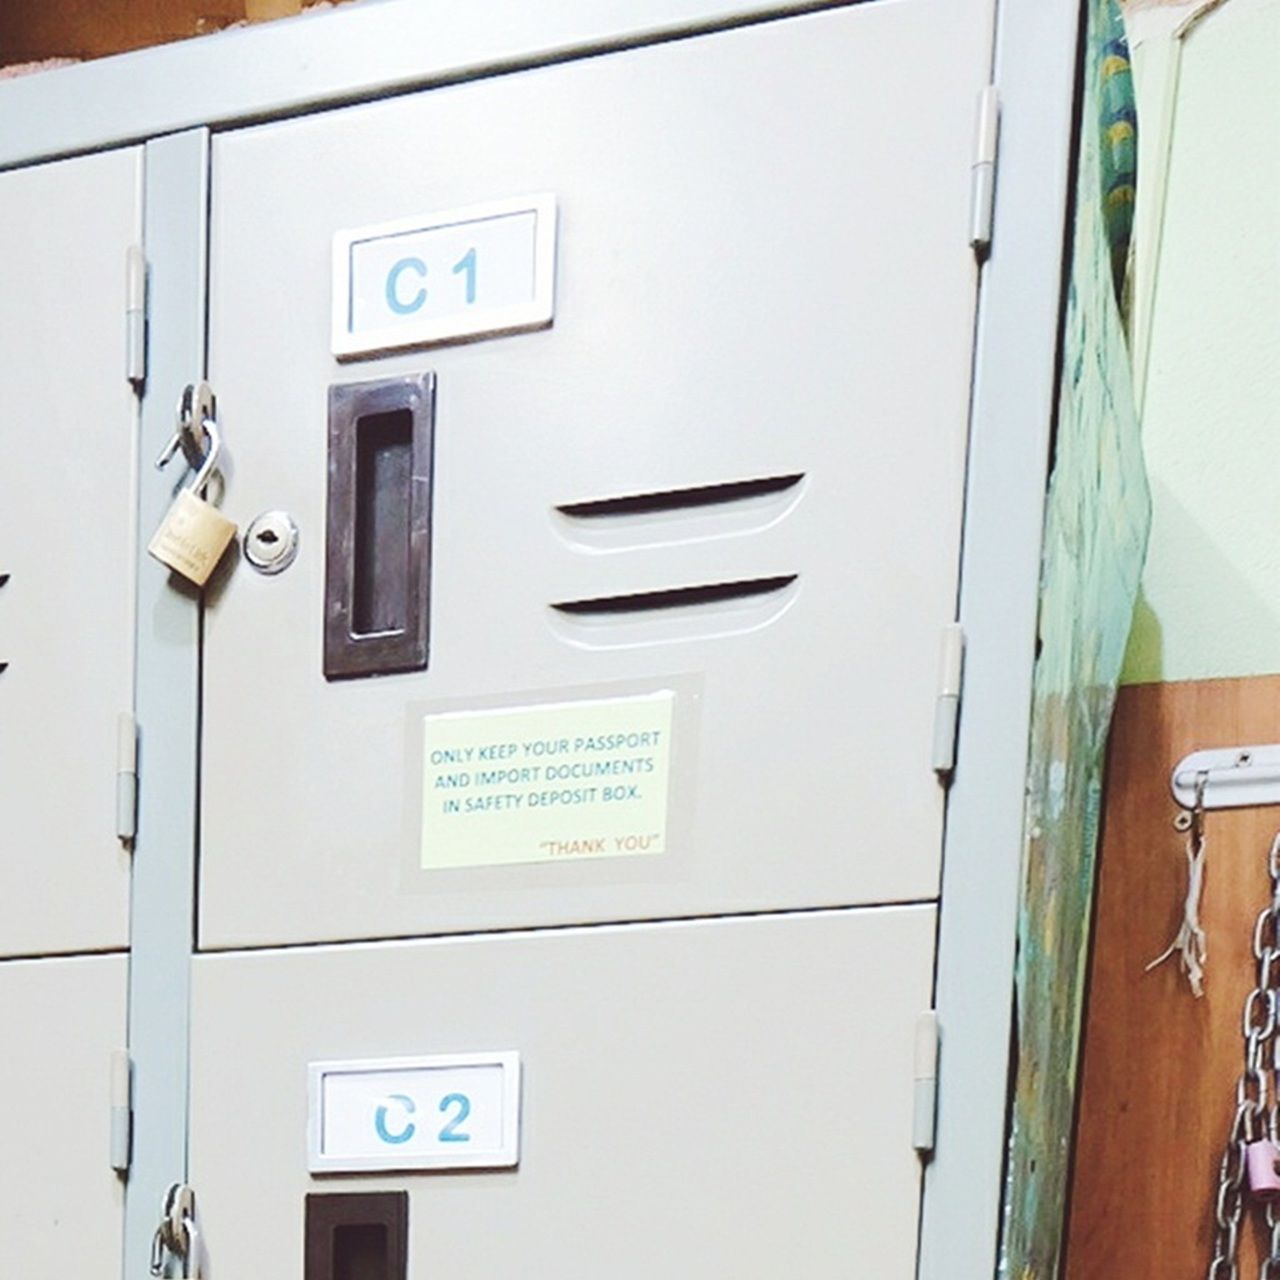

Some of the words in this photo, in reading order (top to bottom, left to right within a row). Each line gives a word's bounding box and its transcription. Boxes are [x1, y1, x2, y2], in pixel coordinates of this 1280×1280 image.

[430, 747, 473, 764] ONLY
[478, 743, 517, 760] KEEP
[522, 738, 569, 756] YOUR
[574, 731, 660, 752] PASSPORT
[434, 772, 470, 788] AND
[475, 766, 540, 785] IMPORT
[545, 757, 654, 780] DOCUMENTS
[442, 798, 459, 813] IN
[465, 793, 523, 811] SAFETY
[527, 787, 597, 806] DEPOSIT
[602, 784, 642, 801] BOX.
